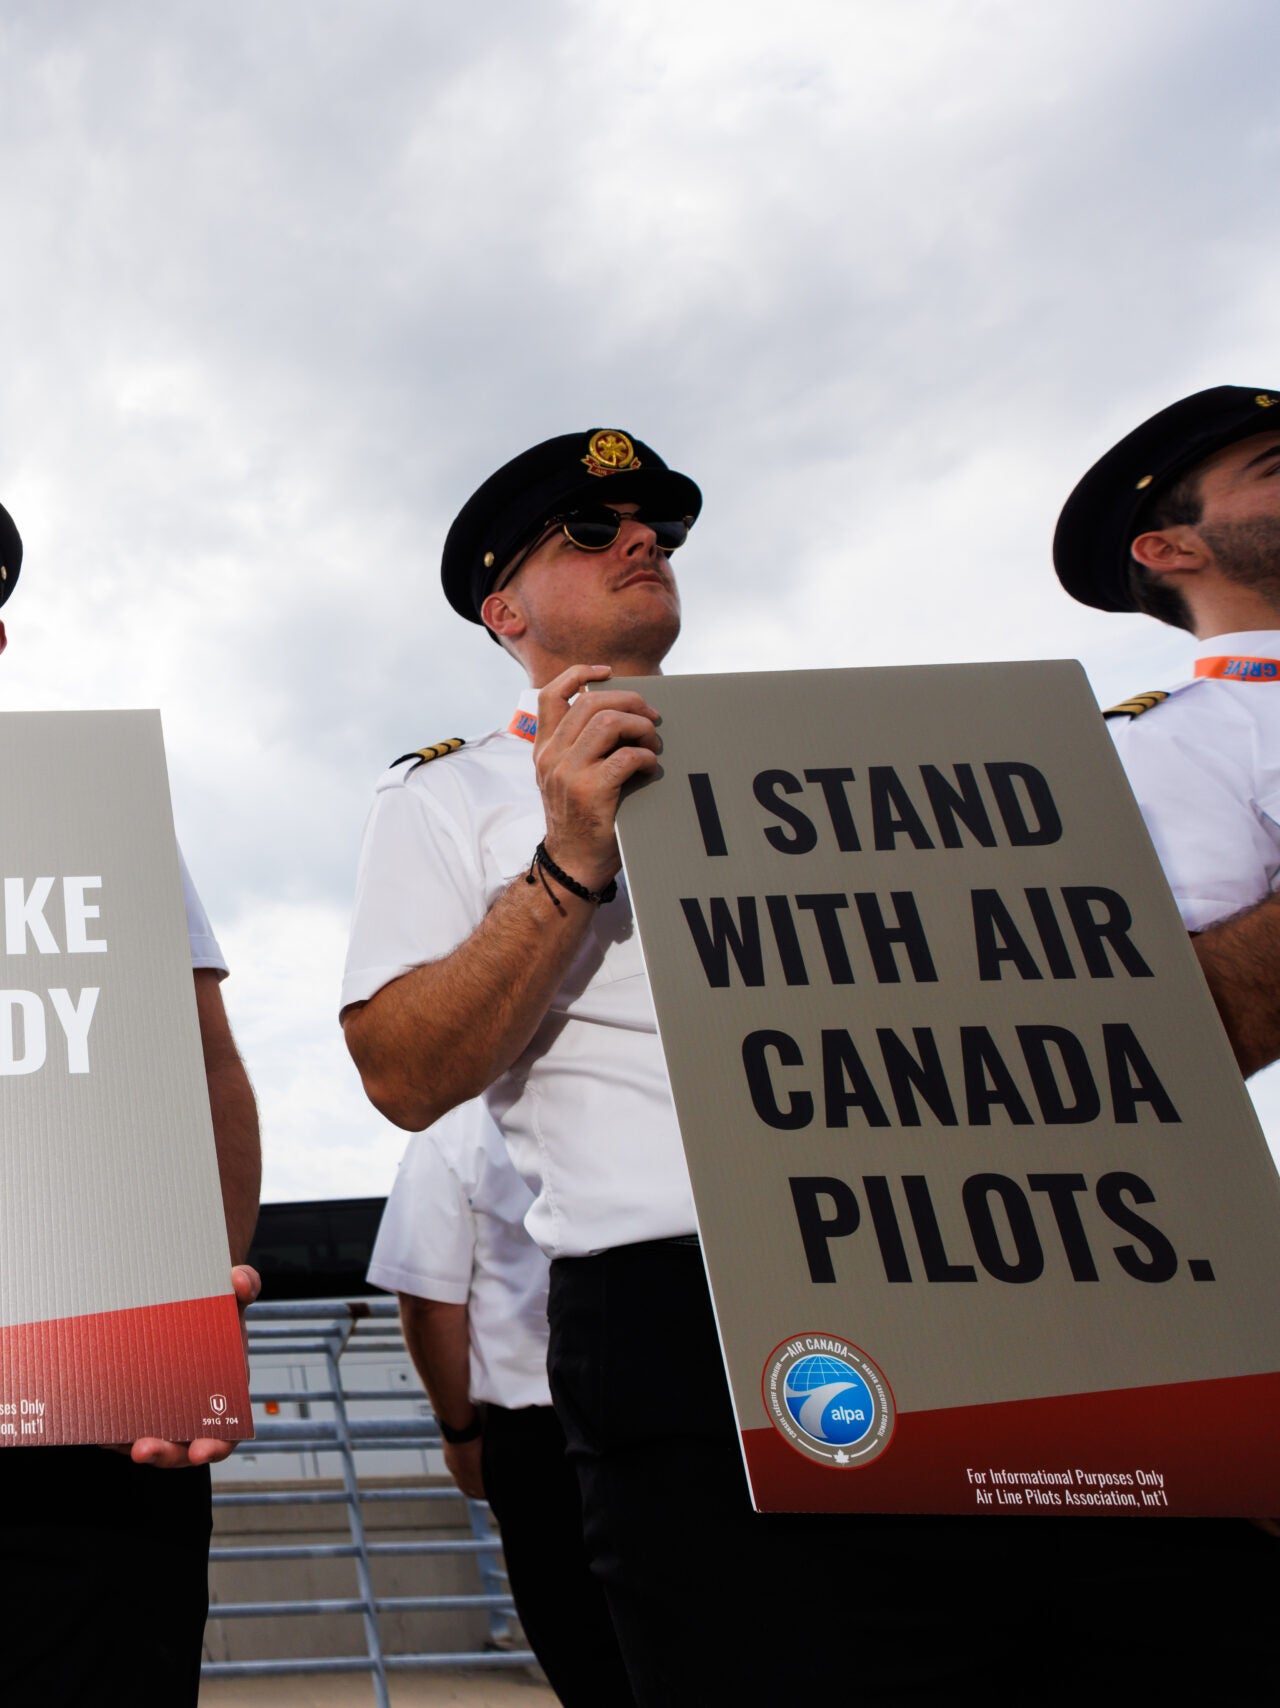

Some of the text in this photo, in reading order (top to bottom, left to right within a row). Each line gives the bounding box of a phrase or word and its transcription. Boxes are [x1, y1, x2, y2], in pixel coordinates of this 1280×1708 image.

[688, 761, 1064, 857] I STAND
[679, 886, 1156, 988] WITH AIR
[741, 1023, 1183, 1131] CANADA
[788, 1171, 1216, 1285] PILOTS.
[787, 1338, 848, 1358] AIR CANADA
[20, 1399, 45, 1417] Only
[831, 1406, 865, 1424] alpa
[21, 1418, 43, 1434] Int'l
[225, 1417, 238, 1425] 704
[967, 1468, 1164, 1488] For Informational Purposes Only
[976, 1488, 1169, 1508] Air Line Pilots Association, Int'l
